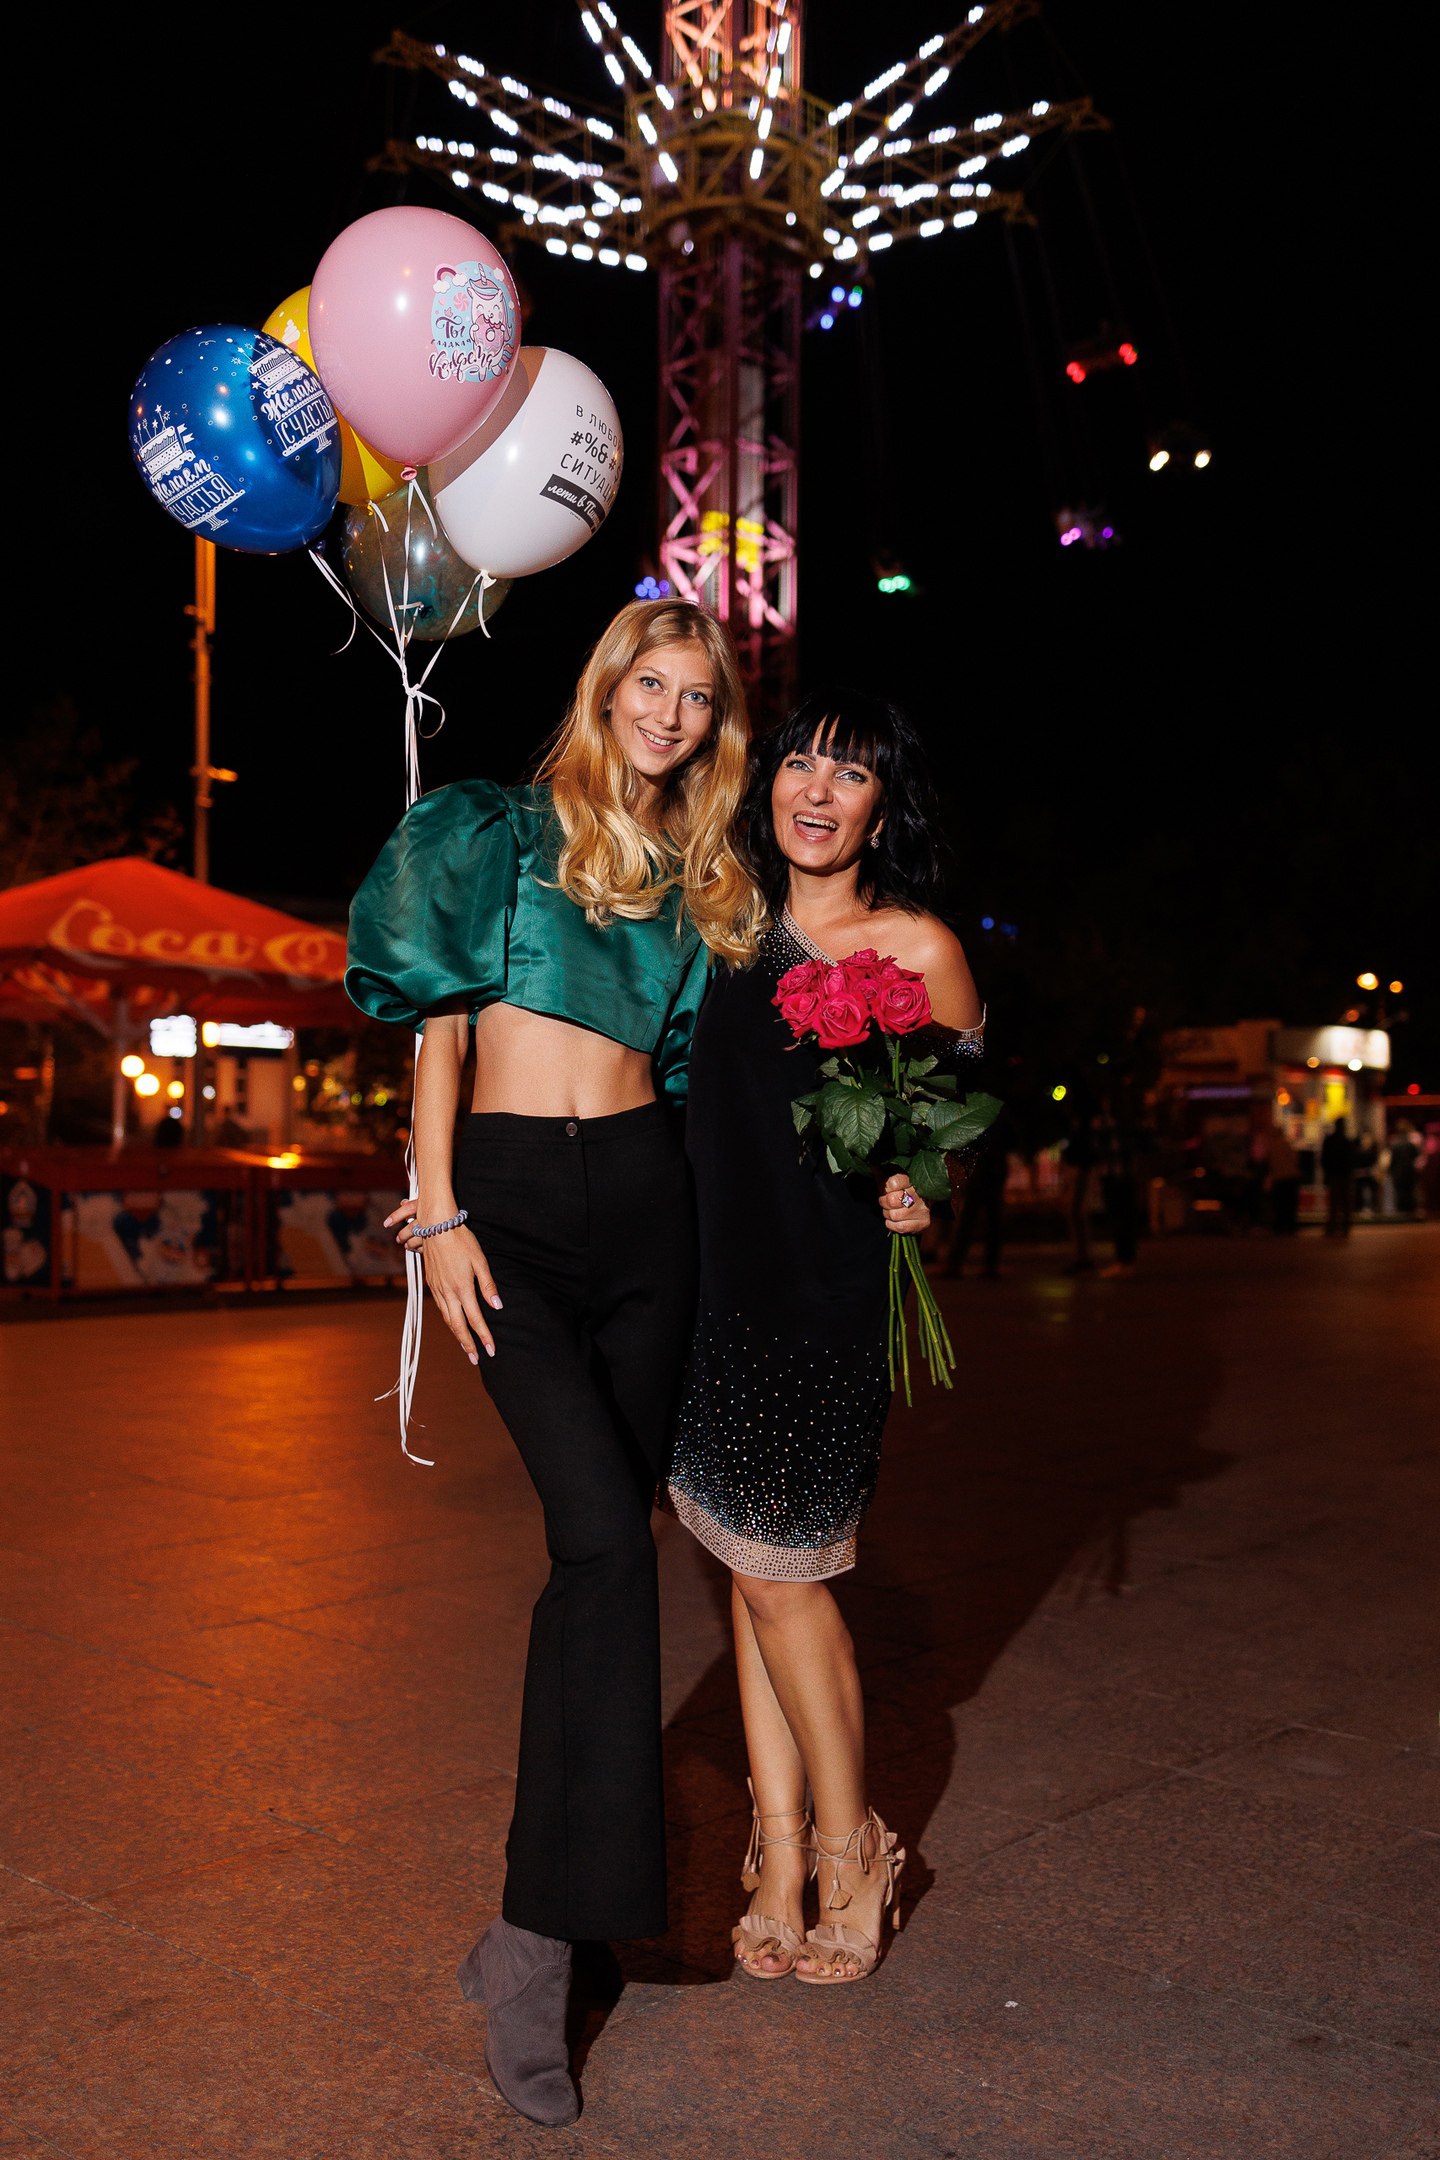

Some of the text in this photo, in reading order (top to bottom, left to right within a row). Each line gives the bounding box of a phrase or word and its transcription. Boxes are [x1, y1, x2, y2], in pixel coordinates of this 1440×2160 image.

[435, 315, 466, 339] Ты
[260, 376, 322, 422] Желаем
[576, 404, 584, 418] В
